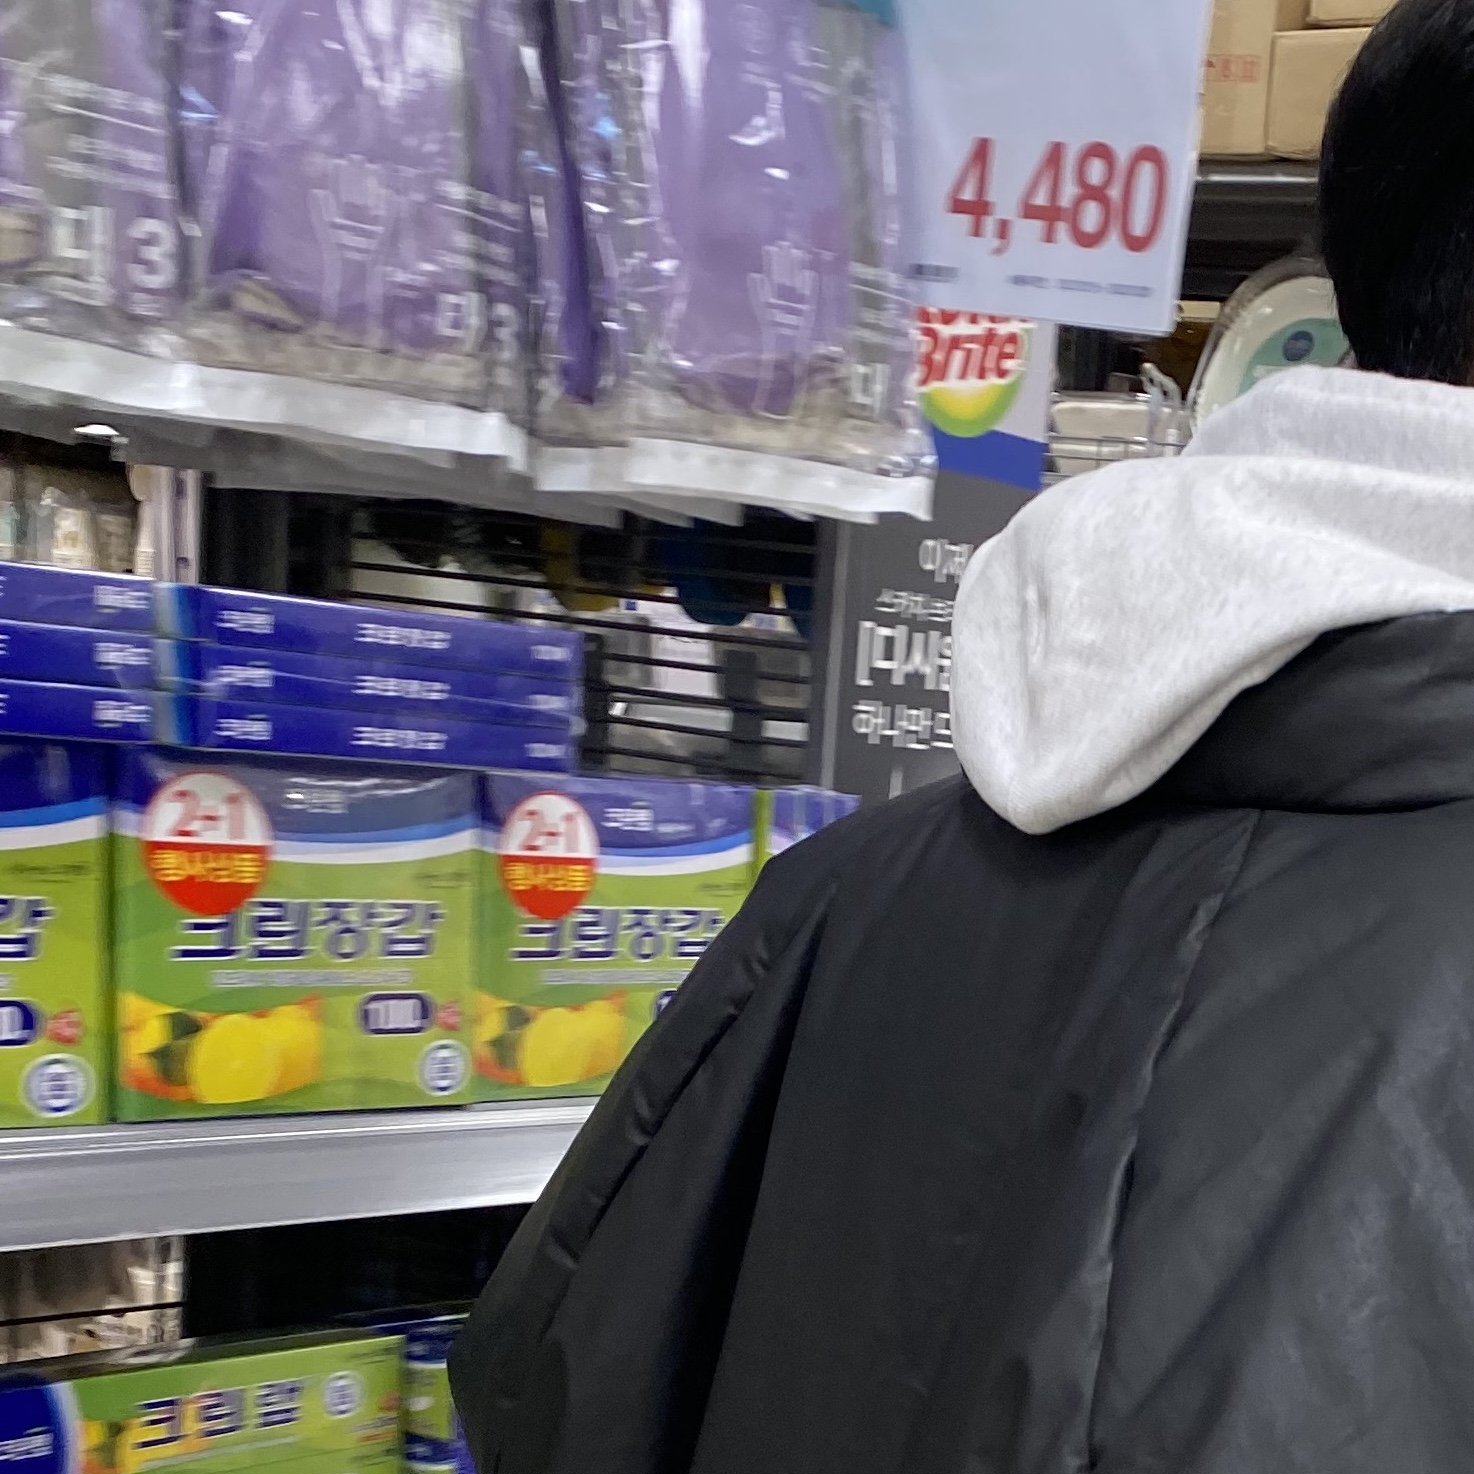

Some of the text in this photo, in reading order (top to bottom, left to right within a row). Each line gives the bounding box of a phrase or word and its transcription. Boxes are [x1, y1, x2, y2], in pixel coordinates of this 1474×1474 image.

[947, 136, 1170, 255] 4,480
[166, 897, 448, 962] 크린장갑
[508, 905, 726, 963] 크린장갑
